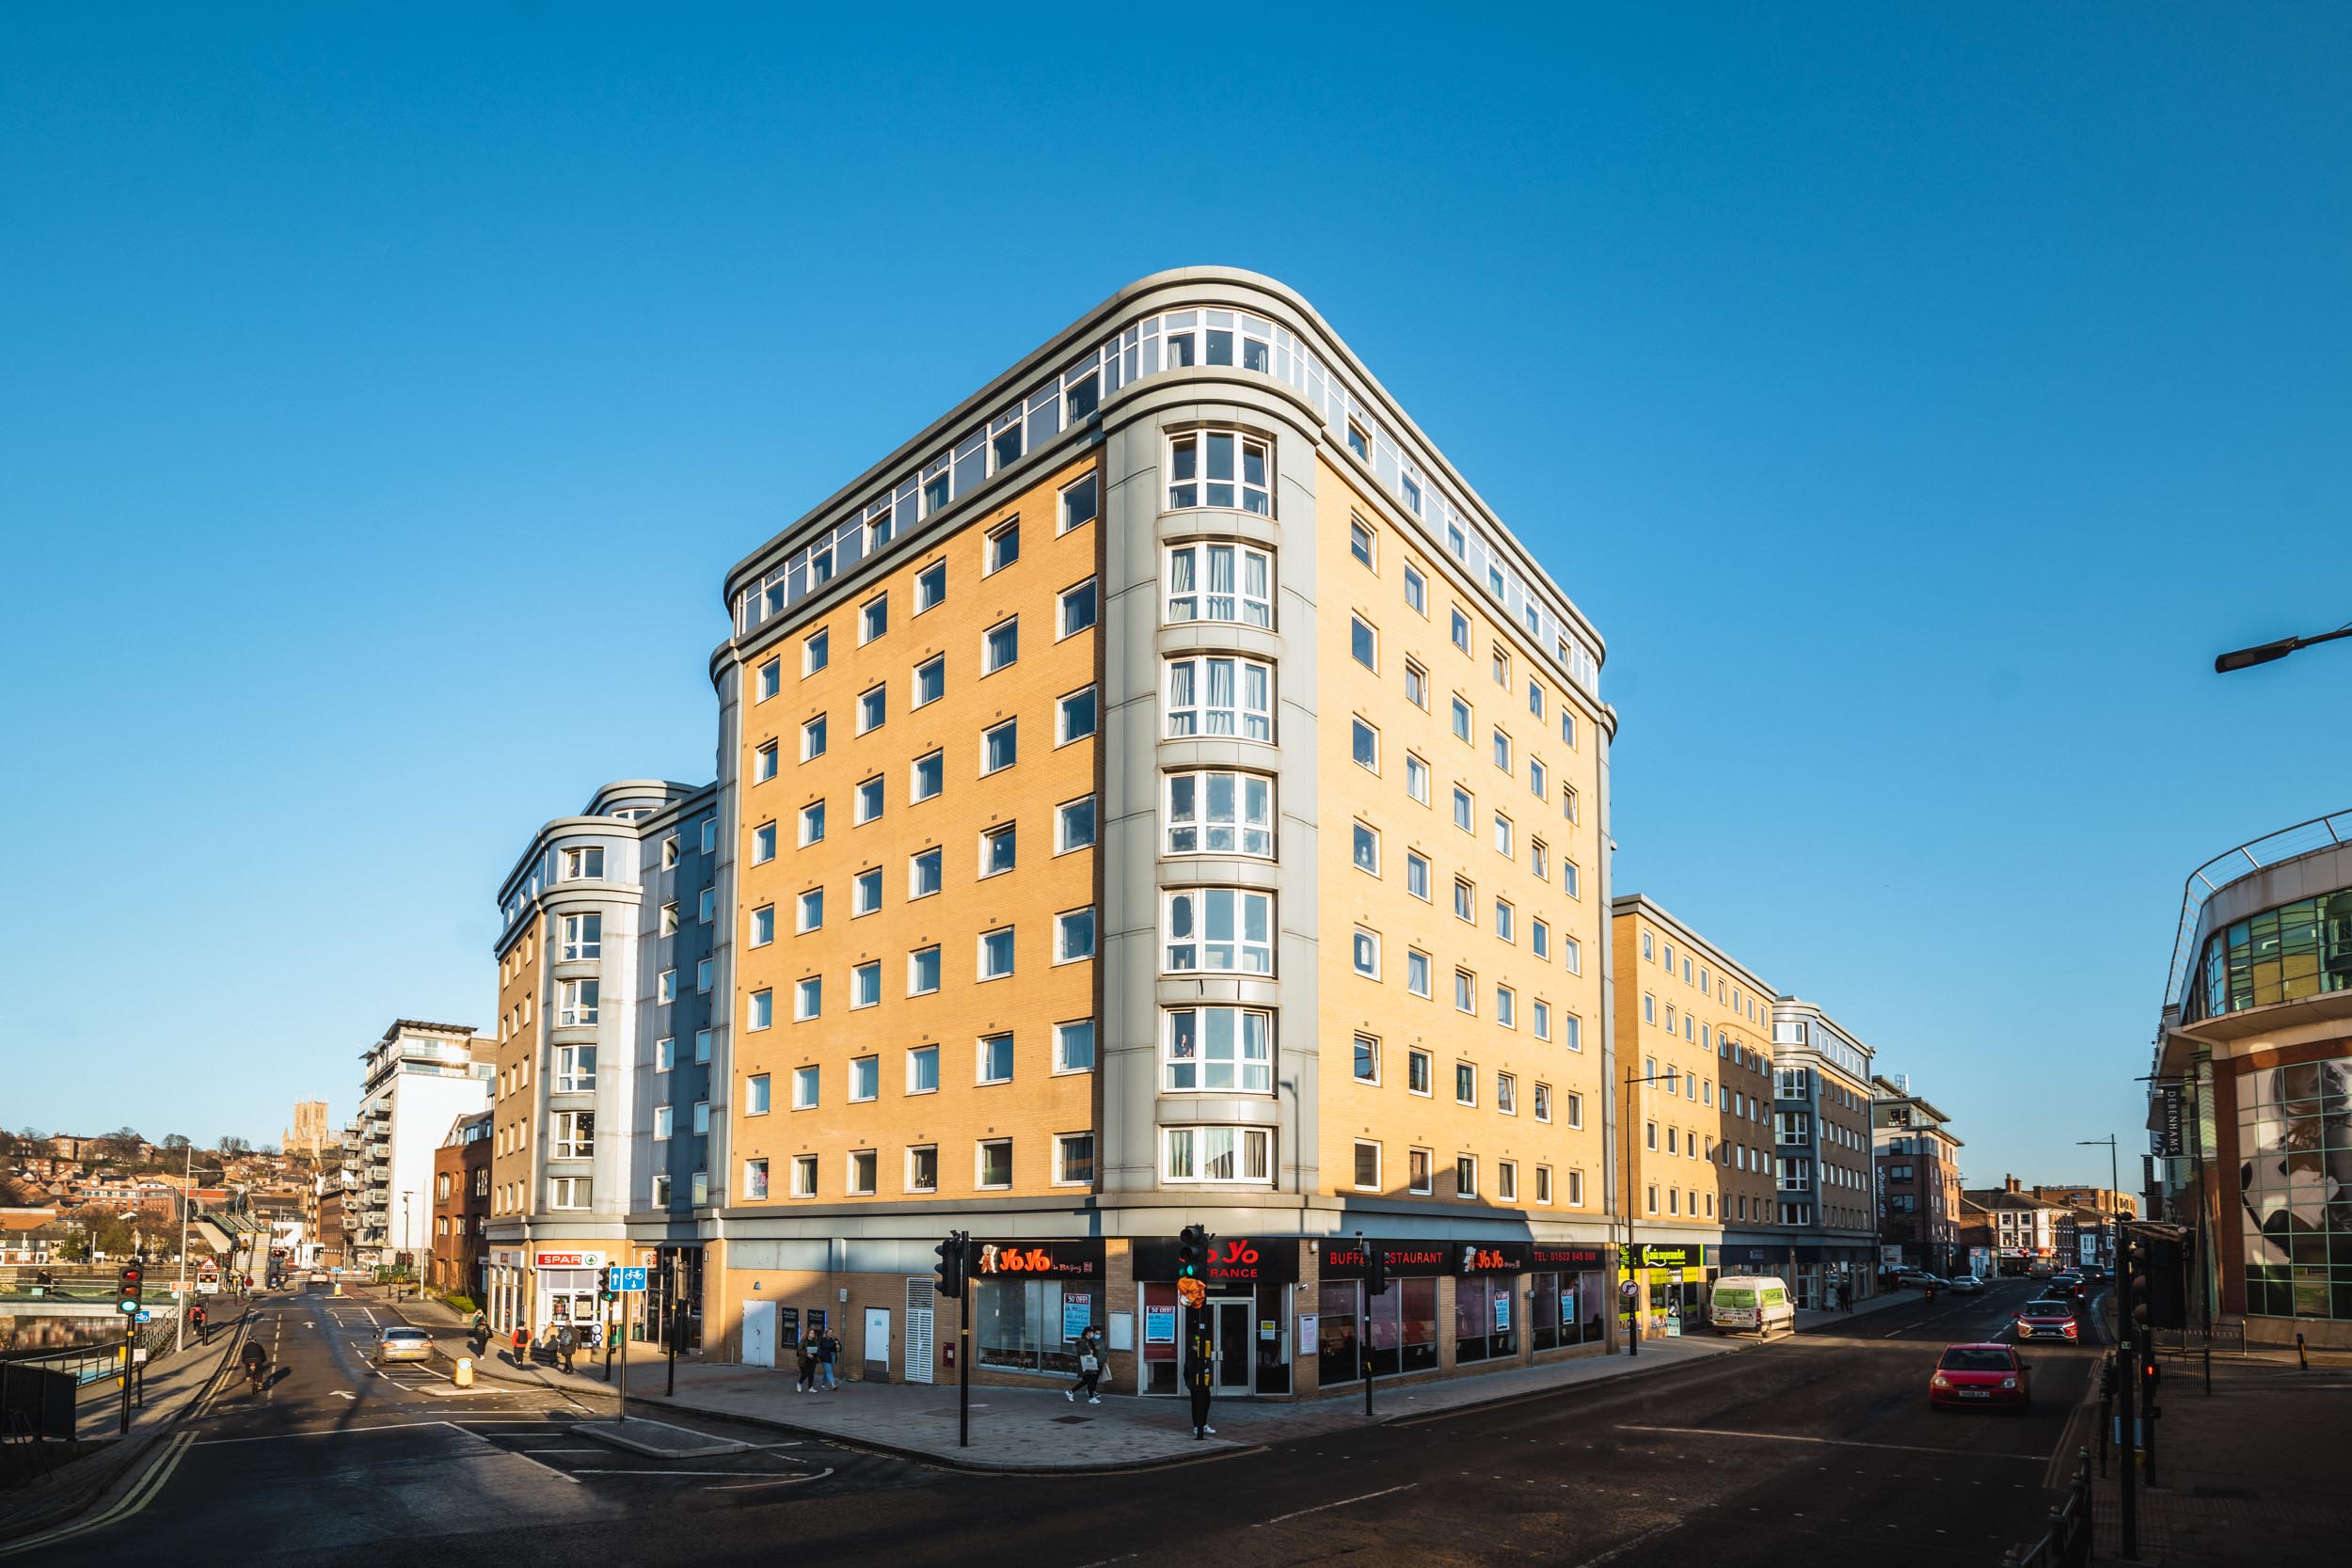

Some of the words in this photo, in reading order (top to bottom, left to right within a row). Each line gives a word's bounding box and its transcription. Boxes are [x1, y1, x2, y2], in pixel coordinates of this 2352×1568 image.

[2167, 1091, 2179, 1152] DEBENHAMS
[544, 1256, 581, 1264] SPAR
[1550, 1251, 1570, 1261] 01522
